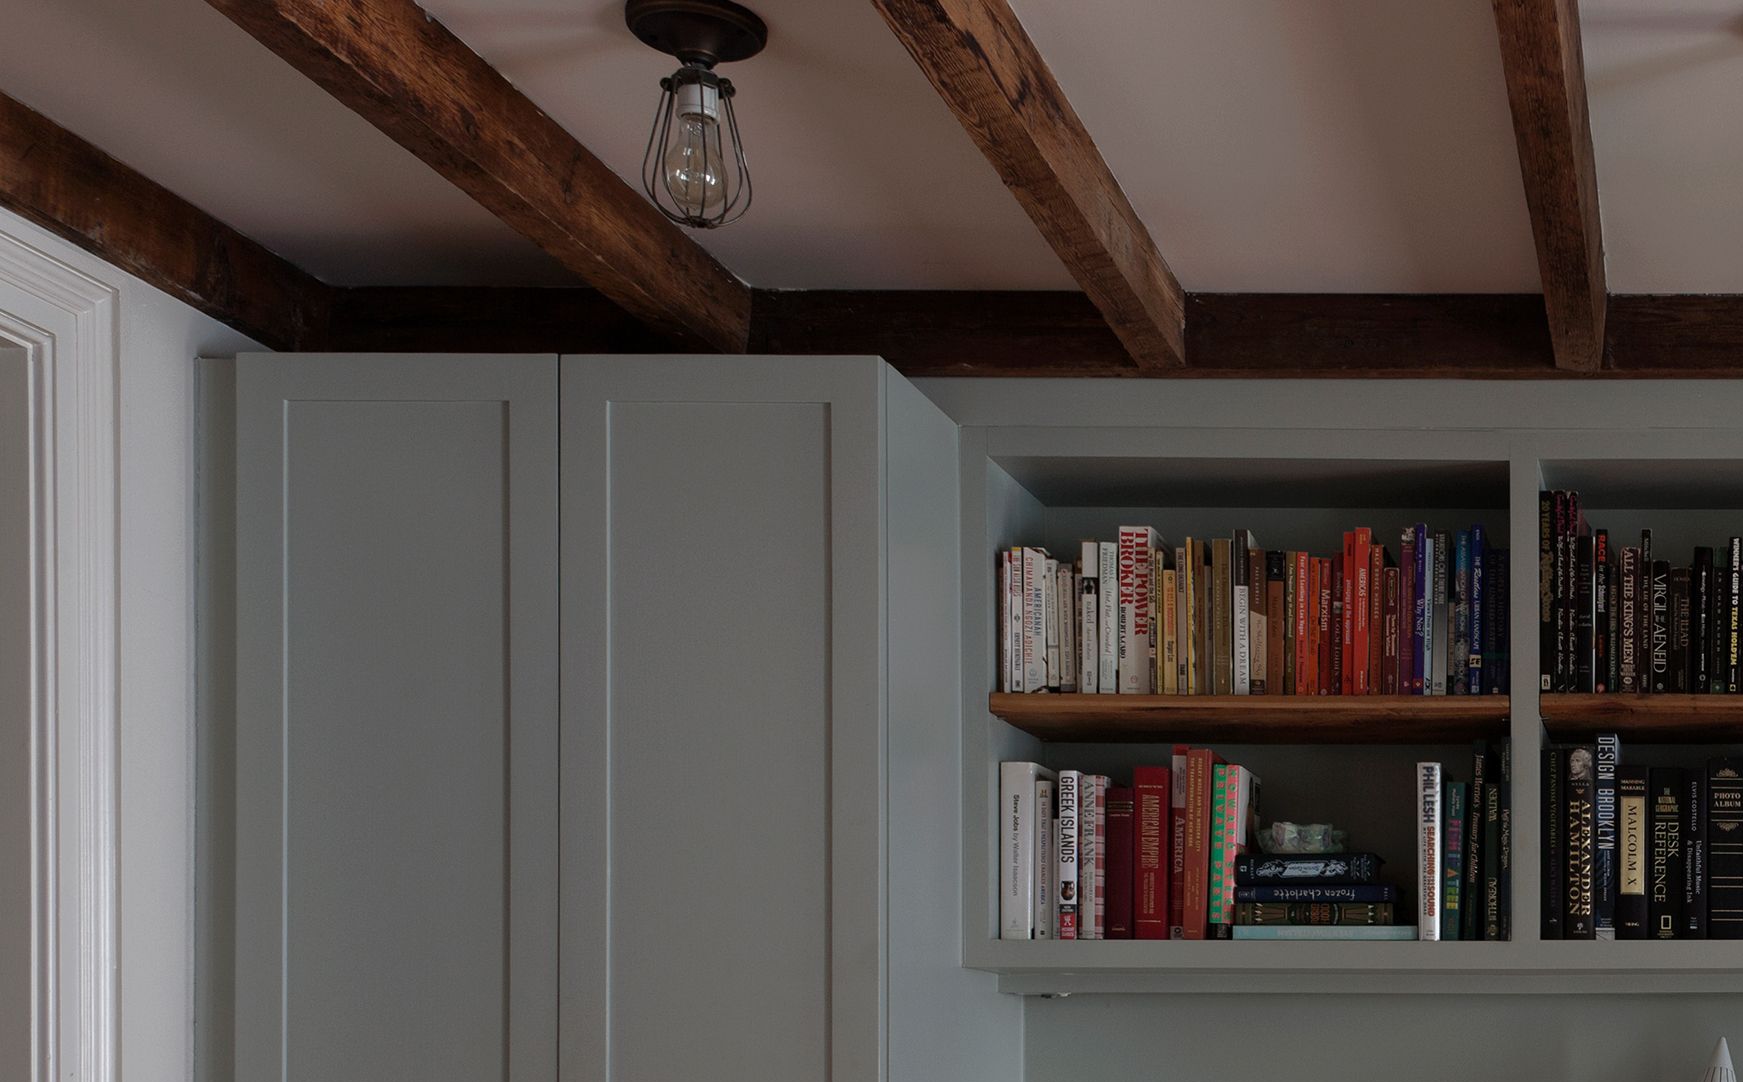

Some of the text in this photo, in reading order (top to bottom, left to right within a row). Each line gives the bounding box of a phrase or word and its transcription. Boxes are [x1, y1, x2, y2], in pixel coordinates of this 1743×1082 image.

[1732, 537, 1740, 572] WINNER'S
[1133, 528, 1148, 636] THE POWER
[1238, 588, 1248, 615] BEGIN
[1623, 549, 1634, 664] ALL THE KING'S MEN
[1731, 595, 1738, 606] TO
[1034, 587, 1042, 636] AMERICANAH
[1239, 616, 1248, 641] WITH
[1321, 589, 1330, 632] Marxism
[1415, 617, 1424, 638] Not?
[1642, 602, 1649, 612] OF
[1653, 573, 1667, 673] VIRGIL AENEID
[1680, 597, 1689, 648] THE ILIAD
[1730, 606, 1738, 630] TEXAS
[1239, 651, 1248, 685] DREAM
[1140, 794, 1159, 836] AMERICAN
[1488, 787, 1498, 823] WALDEN
[1597, 736, 1616, 850] DESIGN BROOKLYN
[1690, 781, 1698, 832] ELVIS COSTELLO
[1713, 800, 1742, 808] ALBUM
[1714, 791, 1742, 799] PHOTO
[1060, 776, 1075, 864] GREEK ISLANDS
[1083, 781, 1095, 868] ANNE FRANK
[1212, 766, 1225, 920] PRIVATE PARTS
[1422, 765, 1437, 917] PHIL LESH SEARCHING SOUND
[1469, 754, 1485, 884] James Herriot's Treasury for Children
[1667, 821, 1680, 858] DESK
[1011, 794, 1020, 896] Steve Jobs by Walter Isaacson
[1141, 837, 1159, 870] EMPIRE
[1173, 815, 1185, 874] AMERICA
[1568, 800, 1580, 915] HAMILTON
[1580, 799, 1591, 917] ALEXANDER
[1626, 804, 1638, 886] MALCOLM X
[1653, 821, 1667, 903] REFERENCE
[1694, 839, 1703, 896] Unfaithful Music
[1272, 888, 1356, 900] frozen charlotte
[1685, 847, 1694, 892] Disappearing
[1686, 891, 1694, 904] Ink
